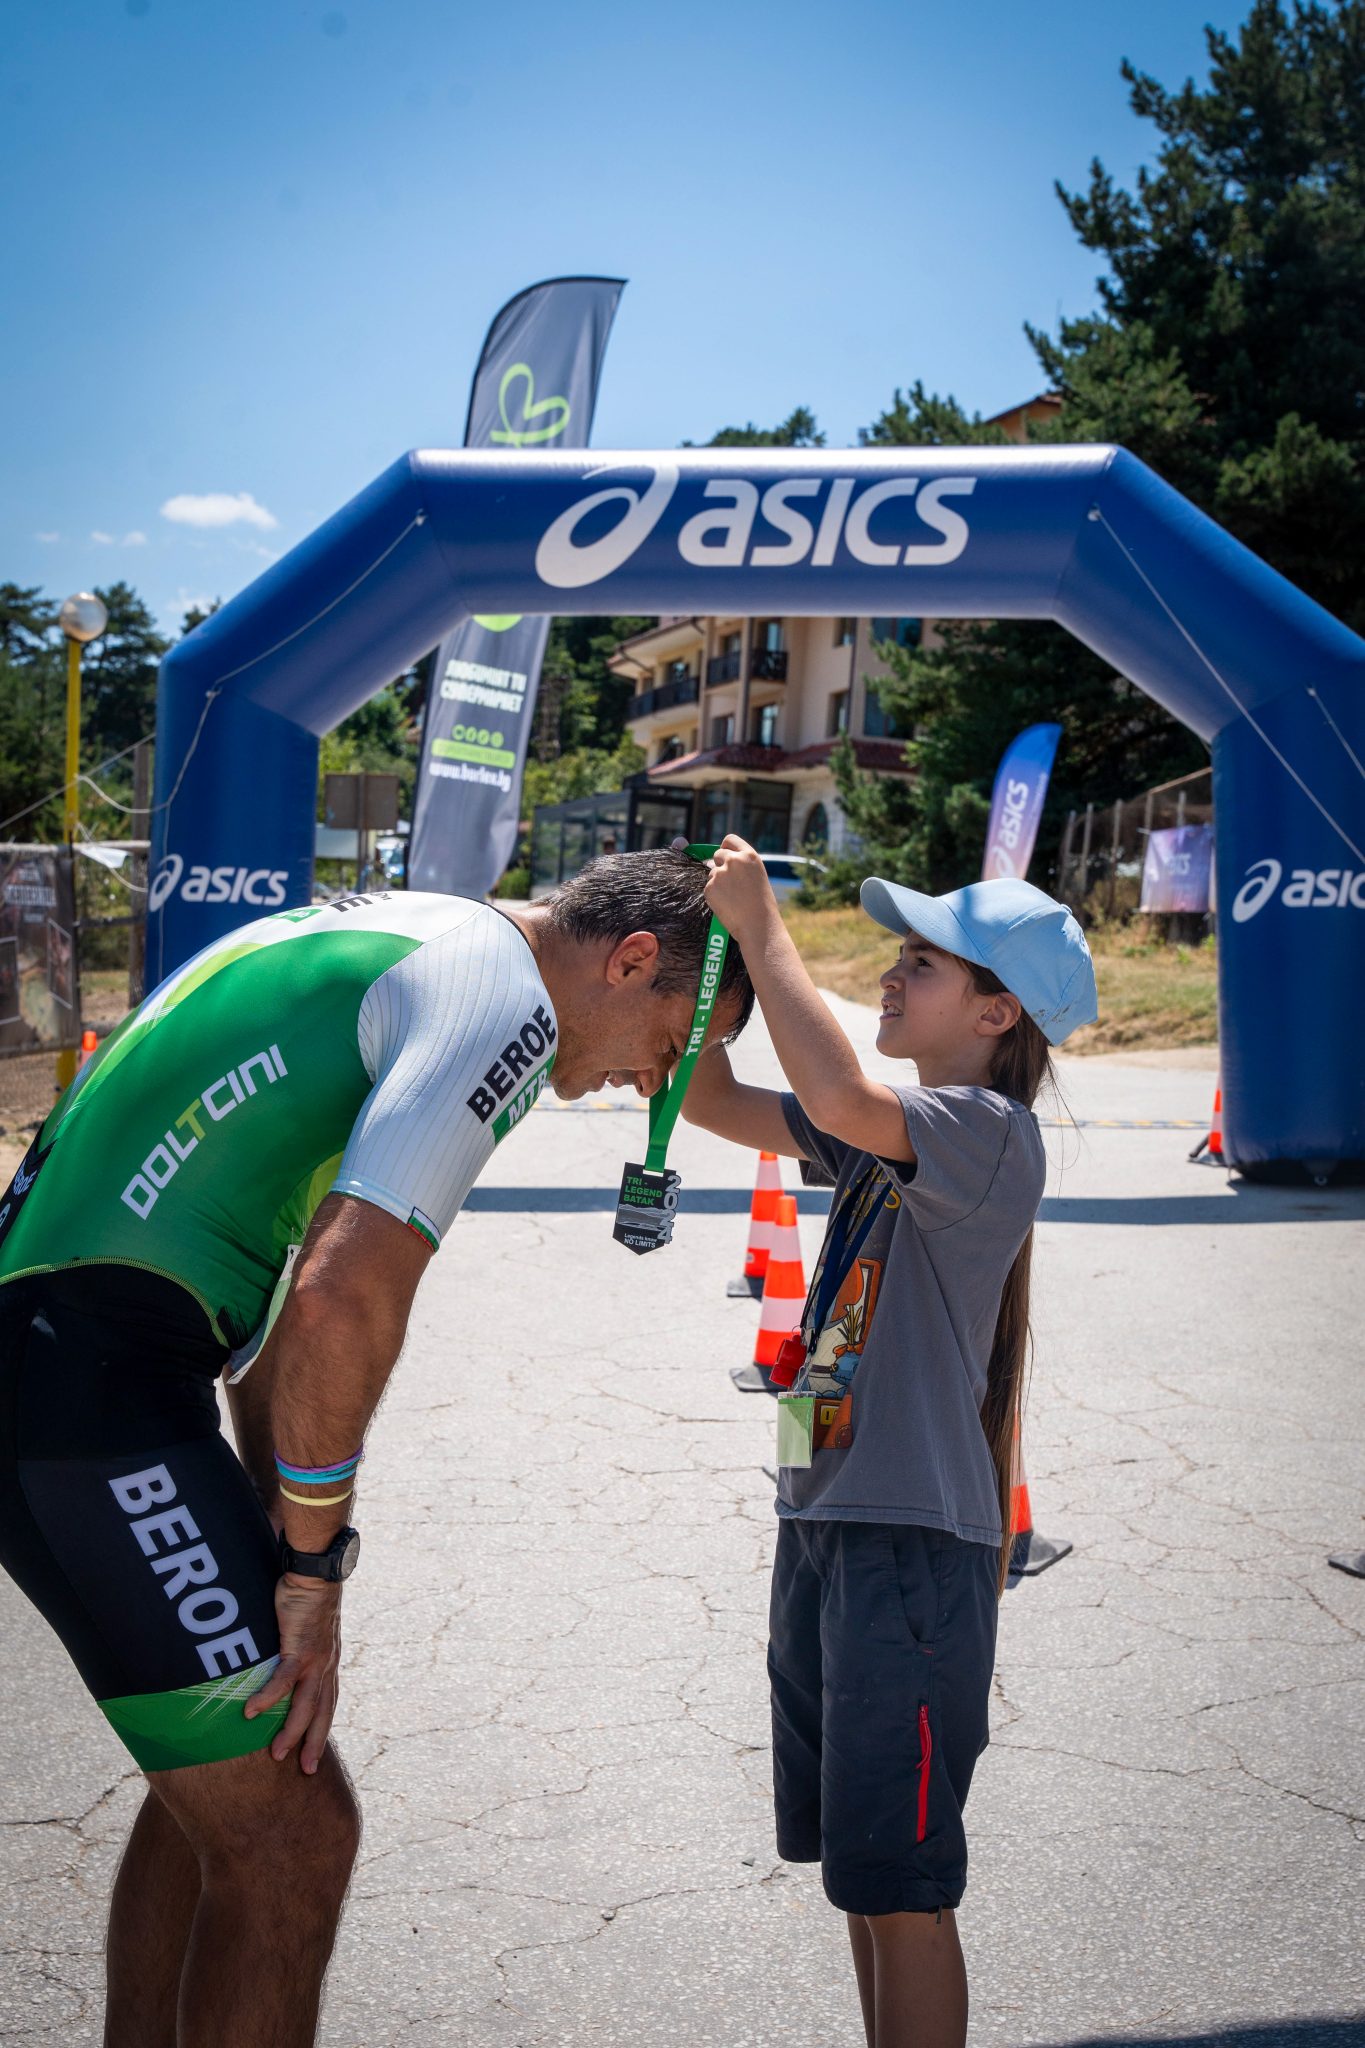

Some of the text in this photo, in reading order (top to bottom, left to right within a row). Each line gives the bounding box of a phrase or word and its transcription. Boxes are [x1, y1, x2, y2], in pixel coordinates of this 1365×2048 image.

[686, 1027, 705, 1056] TRI
[698, 934, 725, 1010] LEGEND
[466, 1004, 557, 1124] BEROE
[120, 1043, 289, 1221] DOLTCINI
[624, 1185, 663, 1198] LEGEND
[626, 1176, 643, 1186] TRI
[623, 1194, 655, 1206] BATAK
[108, 1463, 261, 1679] BEROE
